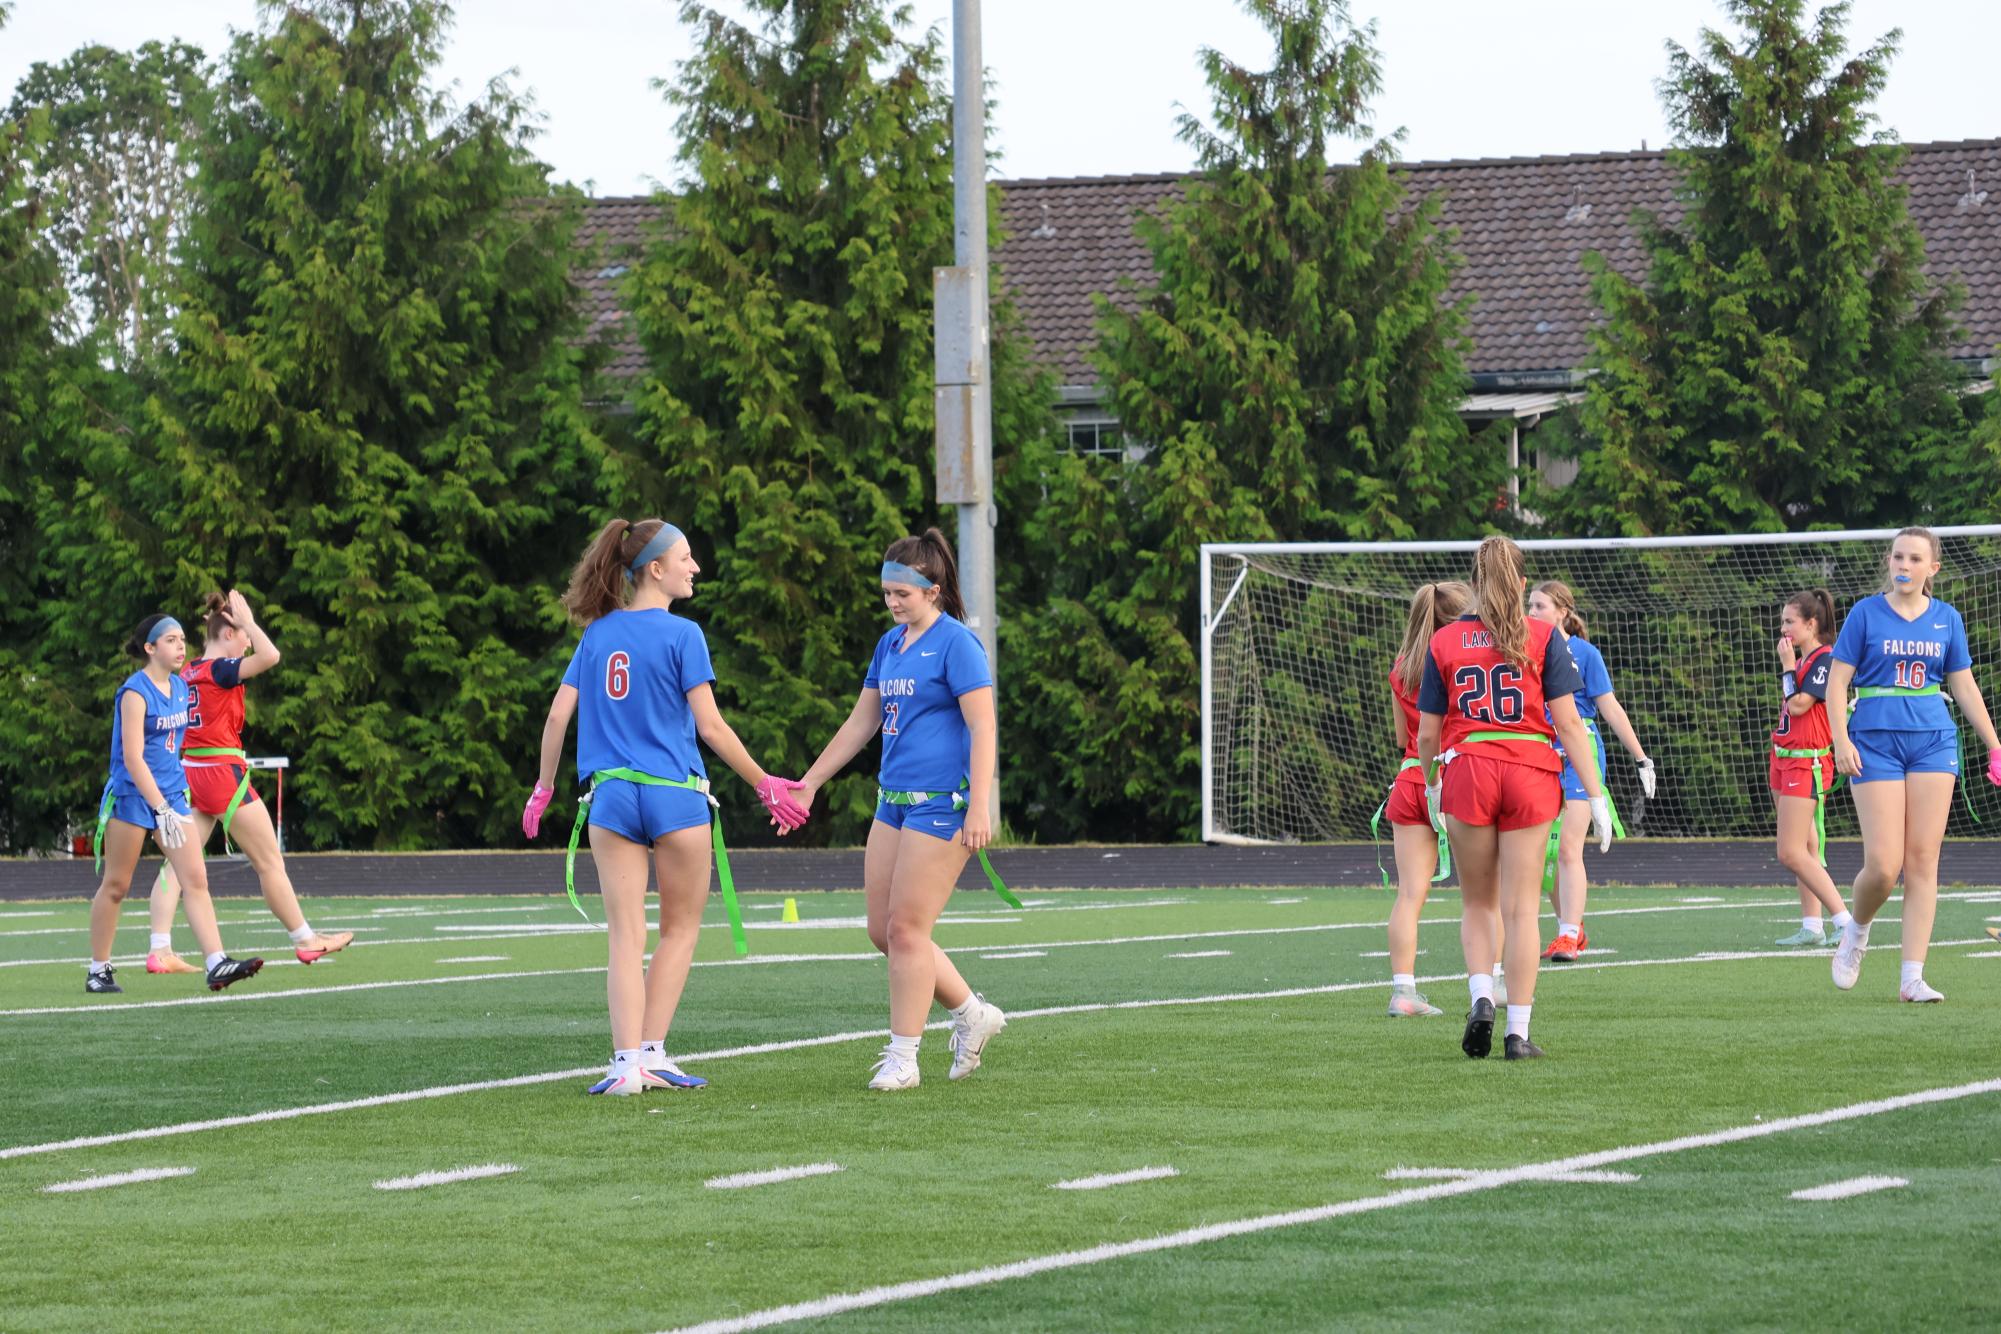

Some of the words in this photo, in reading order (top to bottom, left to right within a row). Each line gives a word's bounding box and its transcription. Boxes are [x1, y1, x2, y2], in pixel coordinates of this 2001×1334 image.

[1462, 631, 1495, 649] LAK
[1884, 639, 1941, 657] FALCONS
[606, 651, 630, 700] 6
[1895, 660, 1927, 689] 16
[1455, 663, 1524, 725] 26
[164, 728, 176, 754] 4
